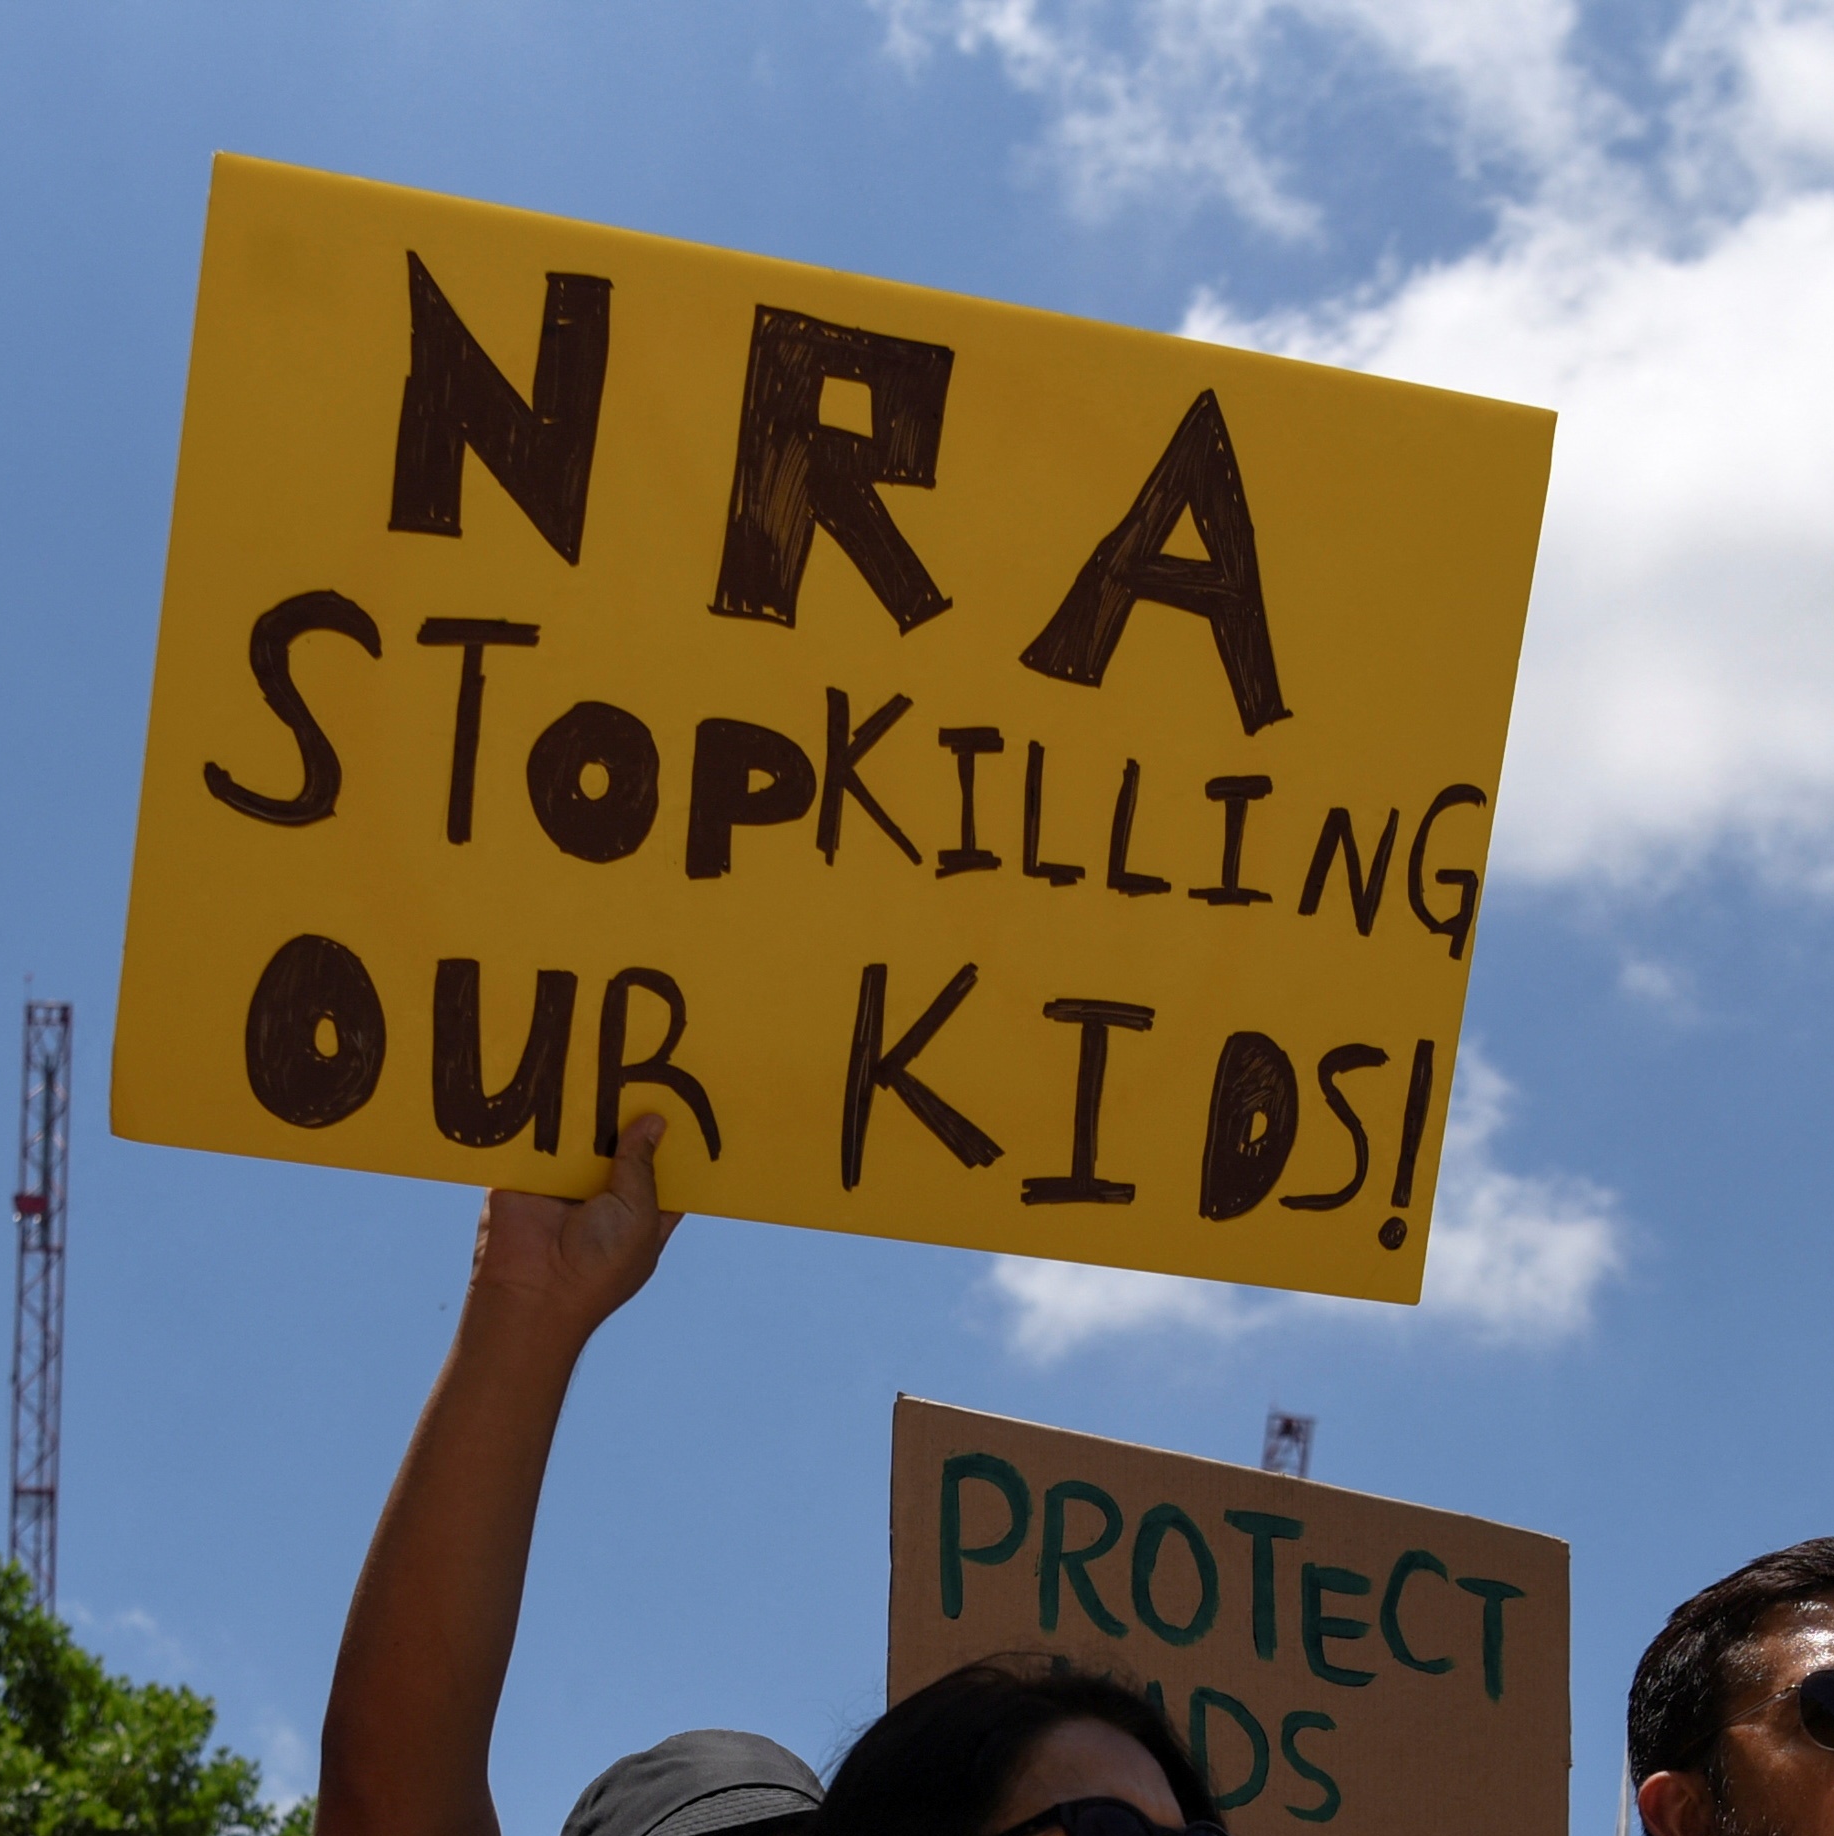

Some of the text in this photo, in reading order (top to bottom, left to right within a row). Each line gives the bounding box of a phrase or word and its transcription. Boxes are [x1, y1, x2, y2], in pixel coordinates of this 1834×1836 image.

[388, 249, 1292, 736] NRA
[203, 588, 1488, 960] STOP KILLING
[244, 932, 1435, 1250] OUR KIDS!
[940, 1452, 1527, 1702] PROTECT
[1149, 1680, 1342, 1824] DS
